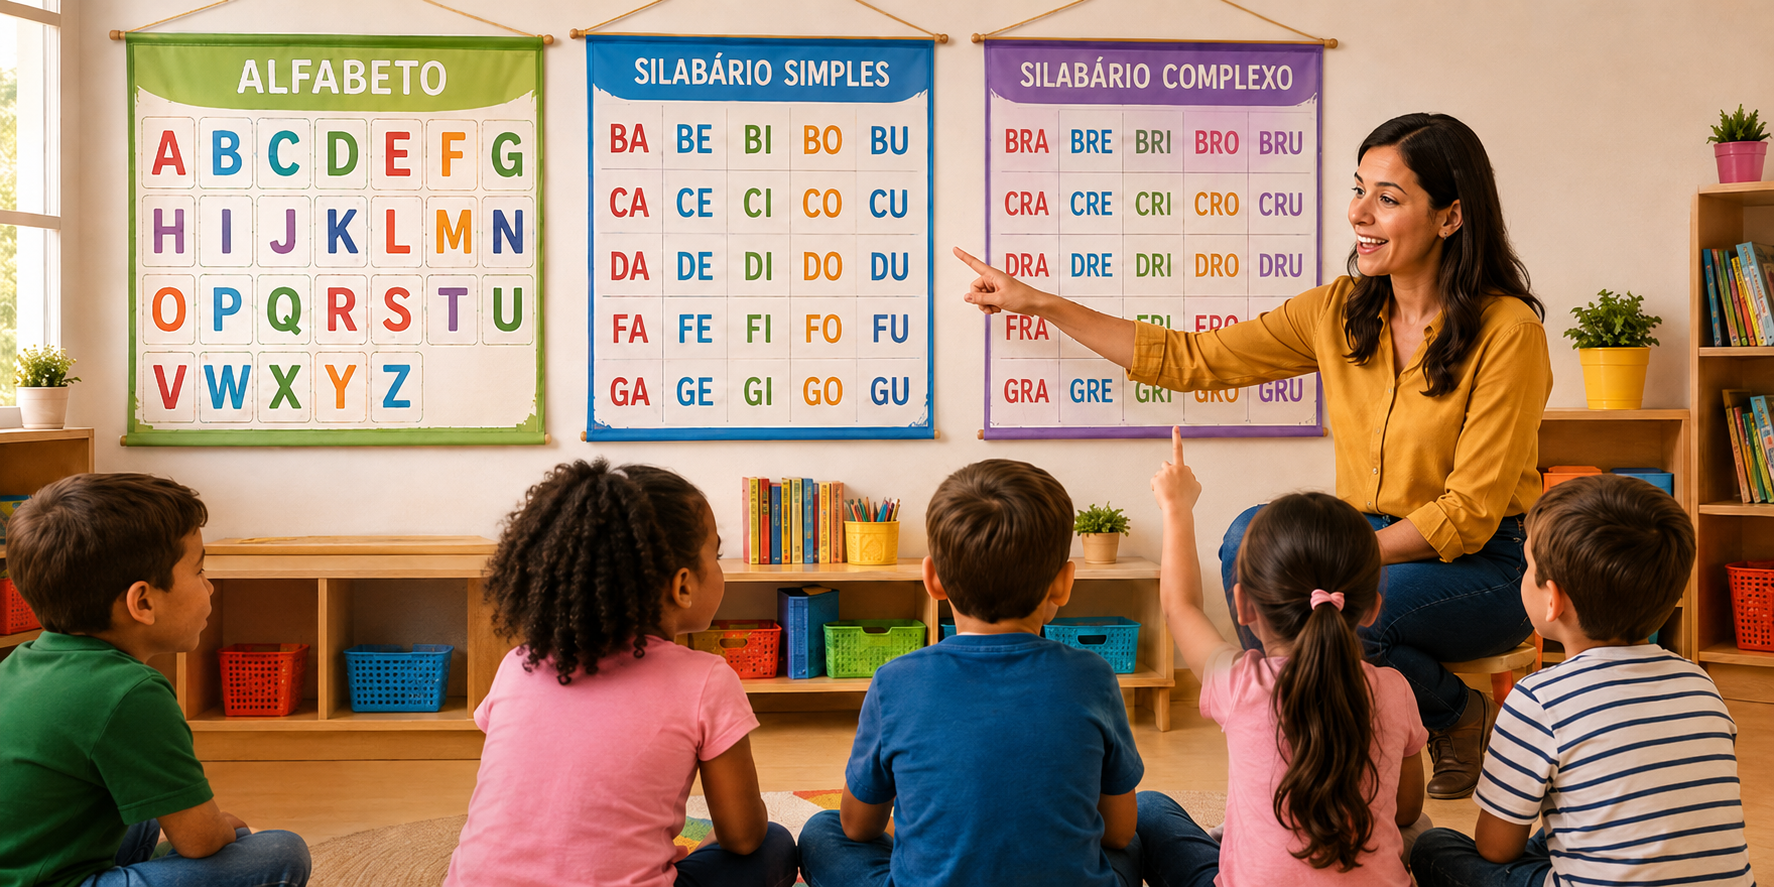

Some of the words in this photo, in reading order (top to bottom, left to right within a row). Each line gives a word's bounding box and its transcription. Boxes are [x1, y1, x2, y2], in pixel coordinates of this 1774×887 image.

[237, 59, 446, 95] ALFABETO
[634, 52, 773, 87] SILABÁRIO
[784, 60, 889, 87] SIMPLES
[1019, 56, 1151, 89] SILABÁRIO
[1163, 64, 1292, 90] COMPLEXO
[152, 130, 186, 175] A
[213, 130, 242, 175] B
[269, 131, 299, 176] C
[328, 132, 358, 176] D
[386, 132, 410, 176] E
[442, 132, 466, 177] F
[492, 132, 522, 177] G
[611, 124, 649, 153] BA
[677, 124, 712, 153] BE
[745, 125, 770, 153] BI
[804, 125, 842, 155] BO
[872, 126, 908, 155] BU
[1006, 129, 1049, 153] BRA
[1072, 130, 1112, 153] BRE
[1136, 130, 1171, 154] BRI
[1196, 130, 1239, 154] BRO
[1260, 131, 1302, 154] BRU
[610, 187, 649, 217] CA
[677, 188, 712, 217] CE
[744, 188, 771, 217] CI
[803, 188, 842, 218] CO
[870, 189, 907, 218] CU
[1005, 191, 1049, 216] CRA
[1071, 192, 1112, 216] CRE
[1136, 192, 1170, 216] CRI
[1195, 192, 1239, 216] CRO
[1260, 193, 1301, 215] CRU
[154, 209, 183, 253] H
[222, 209, 231, 254] I
[271, 210, 295, 253] J
[328, 210, 358, 253] K
[386, 209, 410, 254] L
[436, 210, 471, 254] M
[494, 210, 522, 253] N
[611, 251, 649, 280] DA
[678, 252, 713, 280] DE
[746, 252, 771, 280] DI
[804, 252, 842, 281] DO
[872, 253, 908, 280] DU
[1005, 253, 1050, 278] DRA
[1072, 253, 1112, 277] DRE
[1137, 254, 1171, 277] DRI
[1195, 253, 1239, 277] DRO
[1260, 254, 1301, 276] DRU
[152, 287, 186, 332] O
[214, 288, 241, 331] P
[268, 287, 301, 335] Q
[328, 287, 357, 331] R
[383, 287, 411, 332] S
[438, 288, 468, 332] T
[494, 288, 522, 331] U
[613, 314, 648, 343] FA
[679, 314, 712, 343] FE
[748, 315, 770, 343] FI
[806, 314, 842, 343] FO
[874, 315, 908, 343] FU
[1005, 315, 1050, 341] FRA
[153, 365, 187, 409] V
[204, 365, 251, 409] W
[269, 365, 301, 408] X
[325, 365, 356, 409] Y
[383, 365, 410, 407] Z
[611, 377, 650, 406] GA
[677, 377, 713, 406] GE
[744, 377, 771, 405] GI
[803, 377, 843, 406] GO
[871, 377, 908, 405] GU
[1004, 379, 1049, 403] GRA
[1070, 379, 1112, 403] GRE
[1259, 378, 1302, 402] GRU
